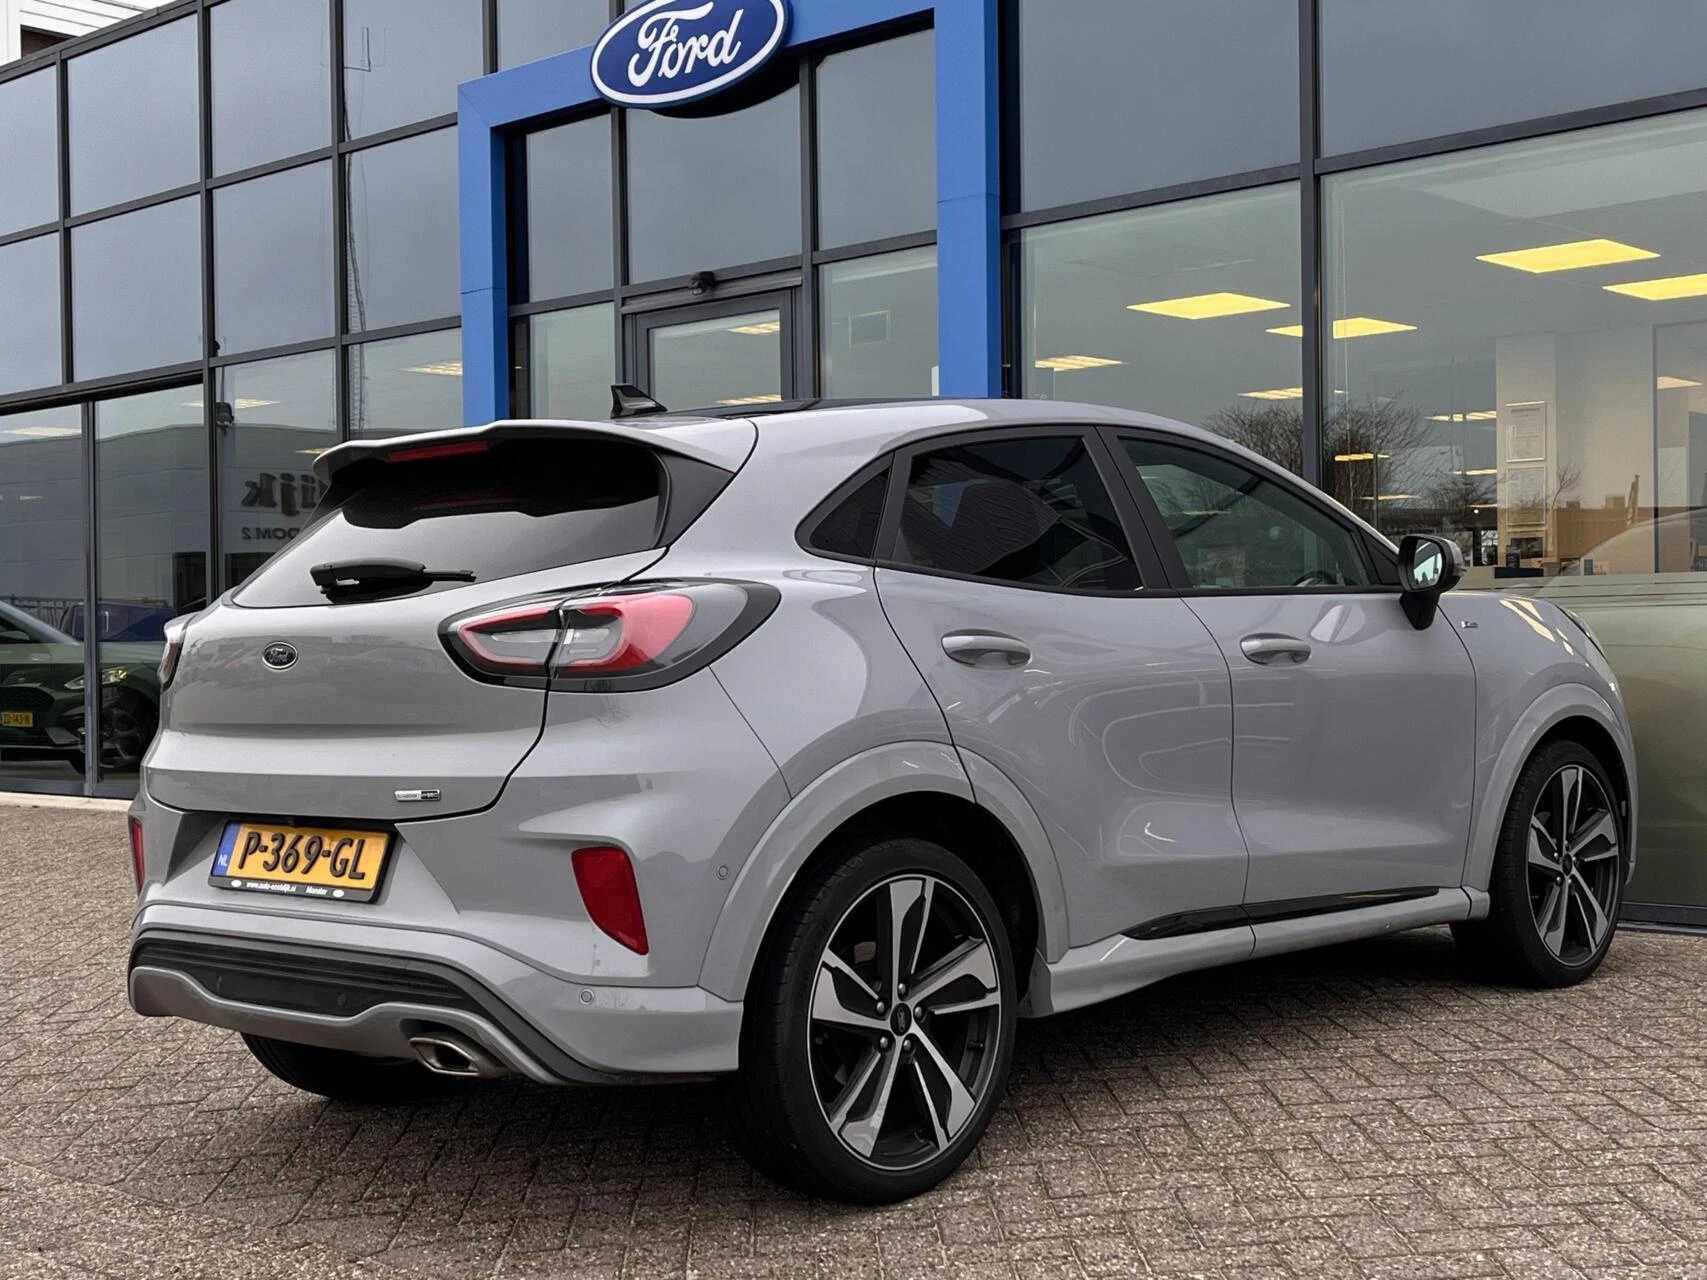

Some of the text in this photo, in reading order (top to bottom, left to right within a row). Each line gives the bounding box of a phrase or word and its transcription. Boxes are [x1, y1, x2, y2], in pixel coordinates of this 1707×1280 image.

[627, 1, 744, 87] Ford
[217, 855, 228, 867] NL
[238, 832, 366, 880] P-369-GL
